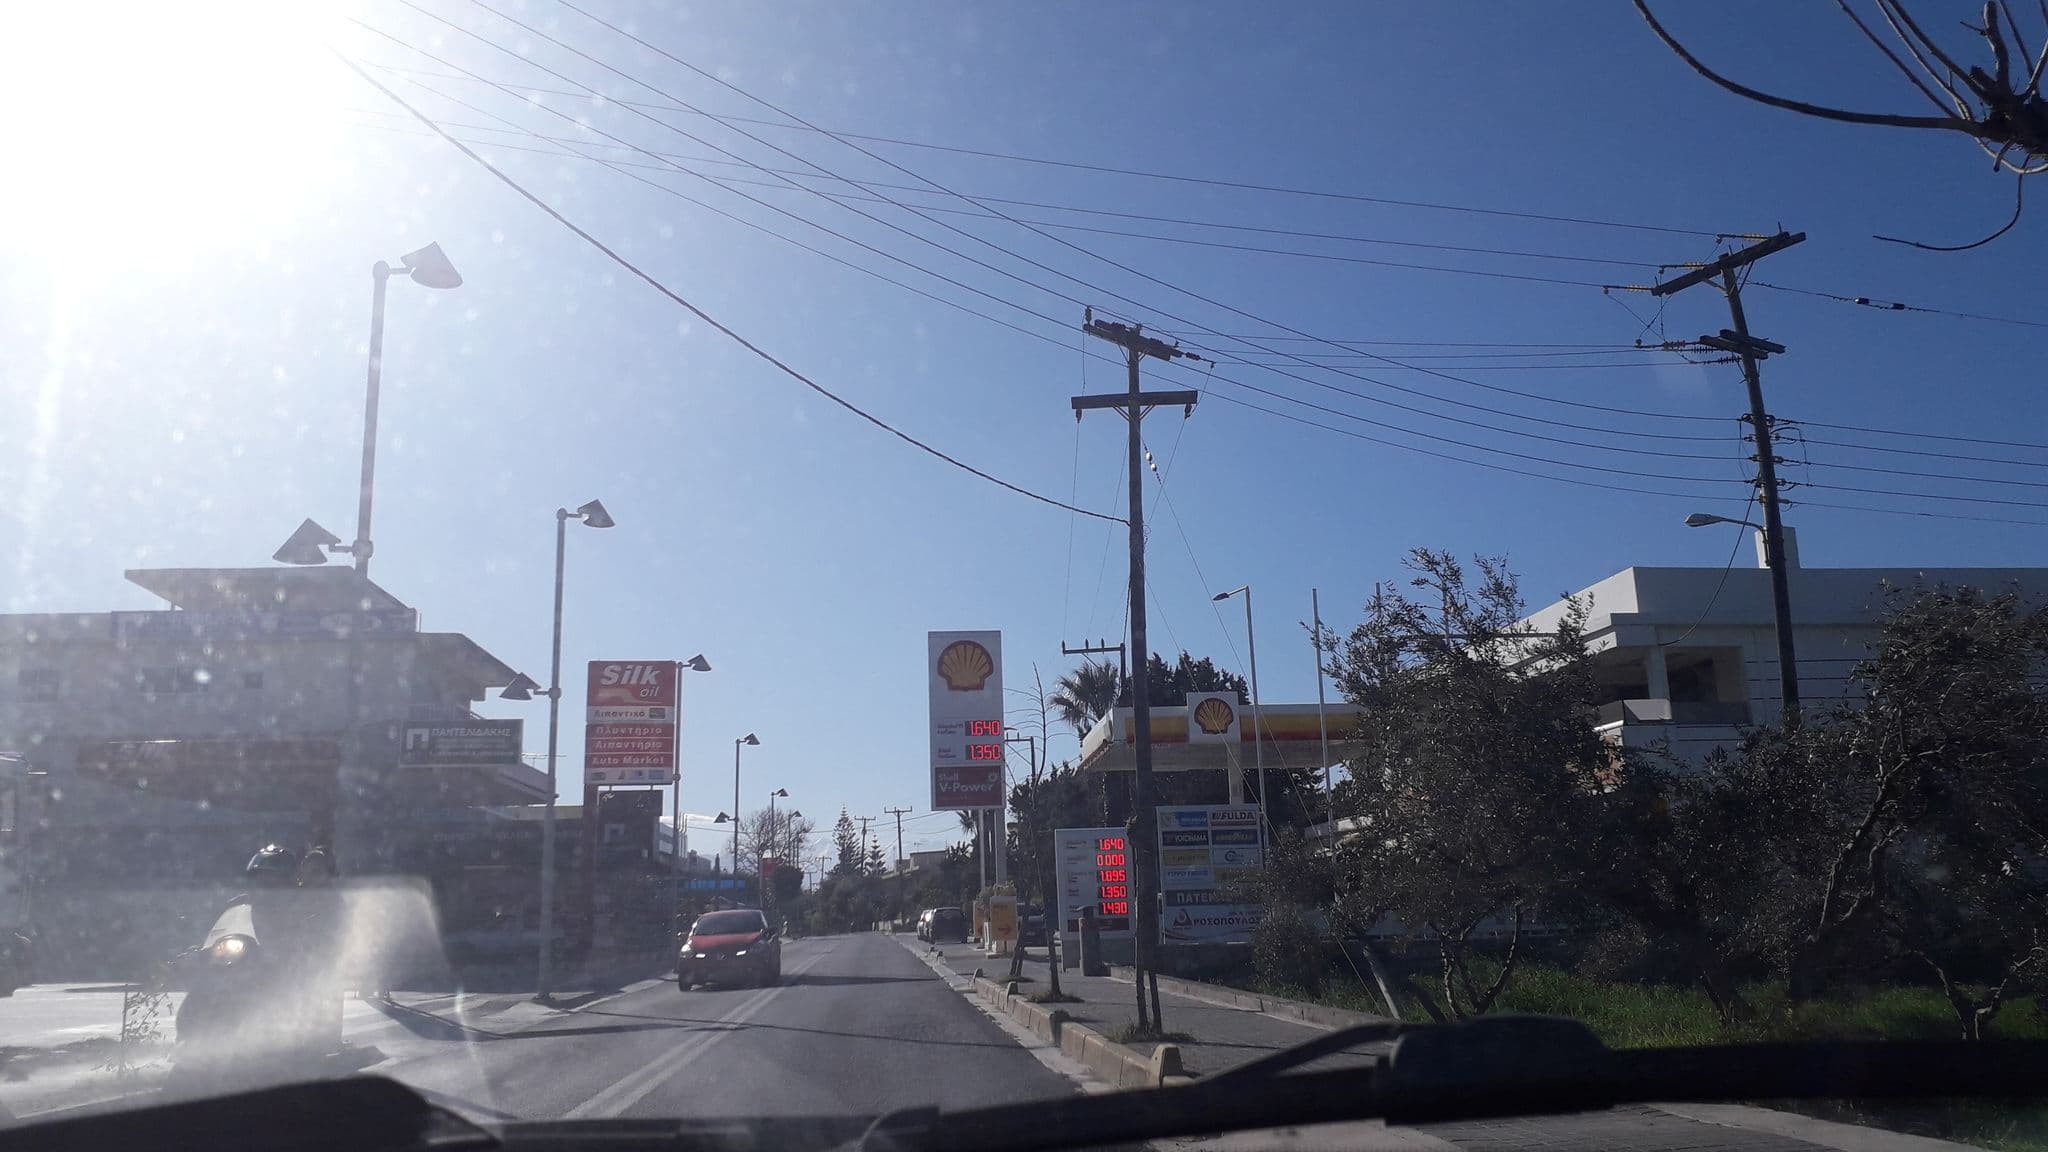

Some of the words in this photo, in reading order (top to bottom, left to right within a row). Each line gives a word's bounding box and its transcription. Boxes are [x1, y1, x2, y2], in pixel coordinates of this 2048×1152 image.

[601, 664, 661, 686] Silk
[639, 686, 660, 697] oil
[939, 782, 993, 792] V-Power
[1222, 811, 1255, 820] FULDA
